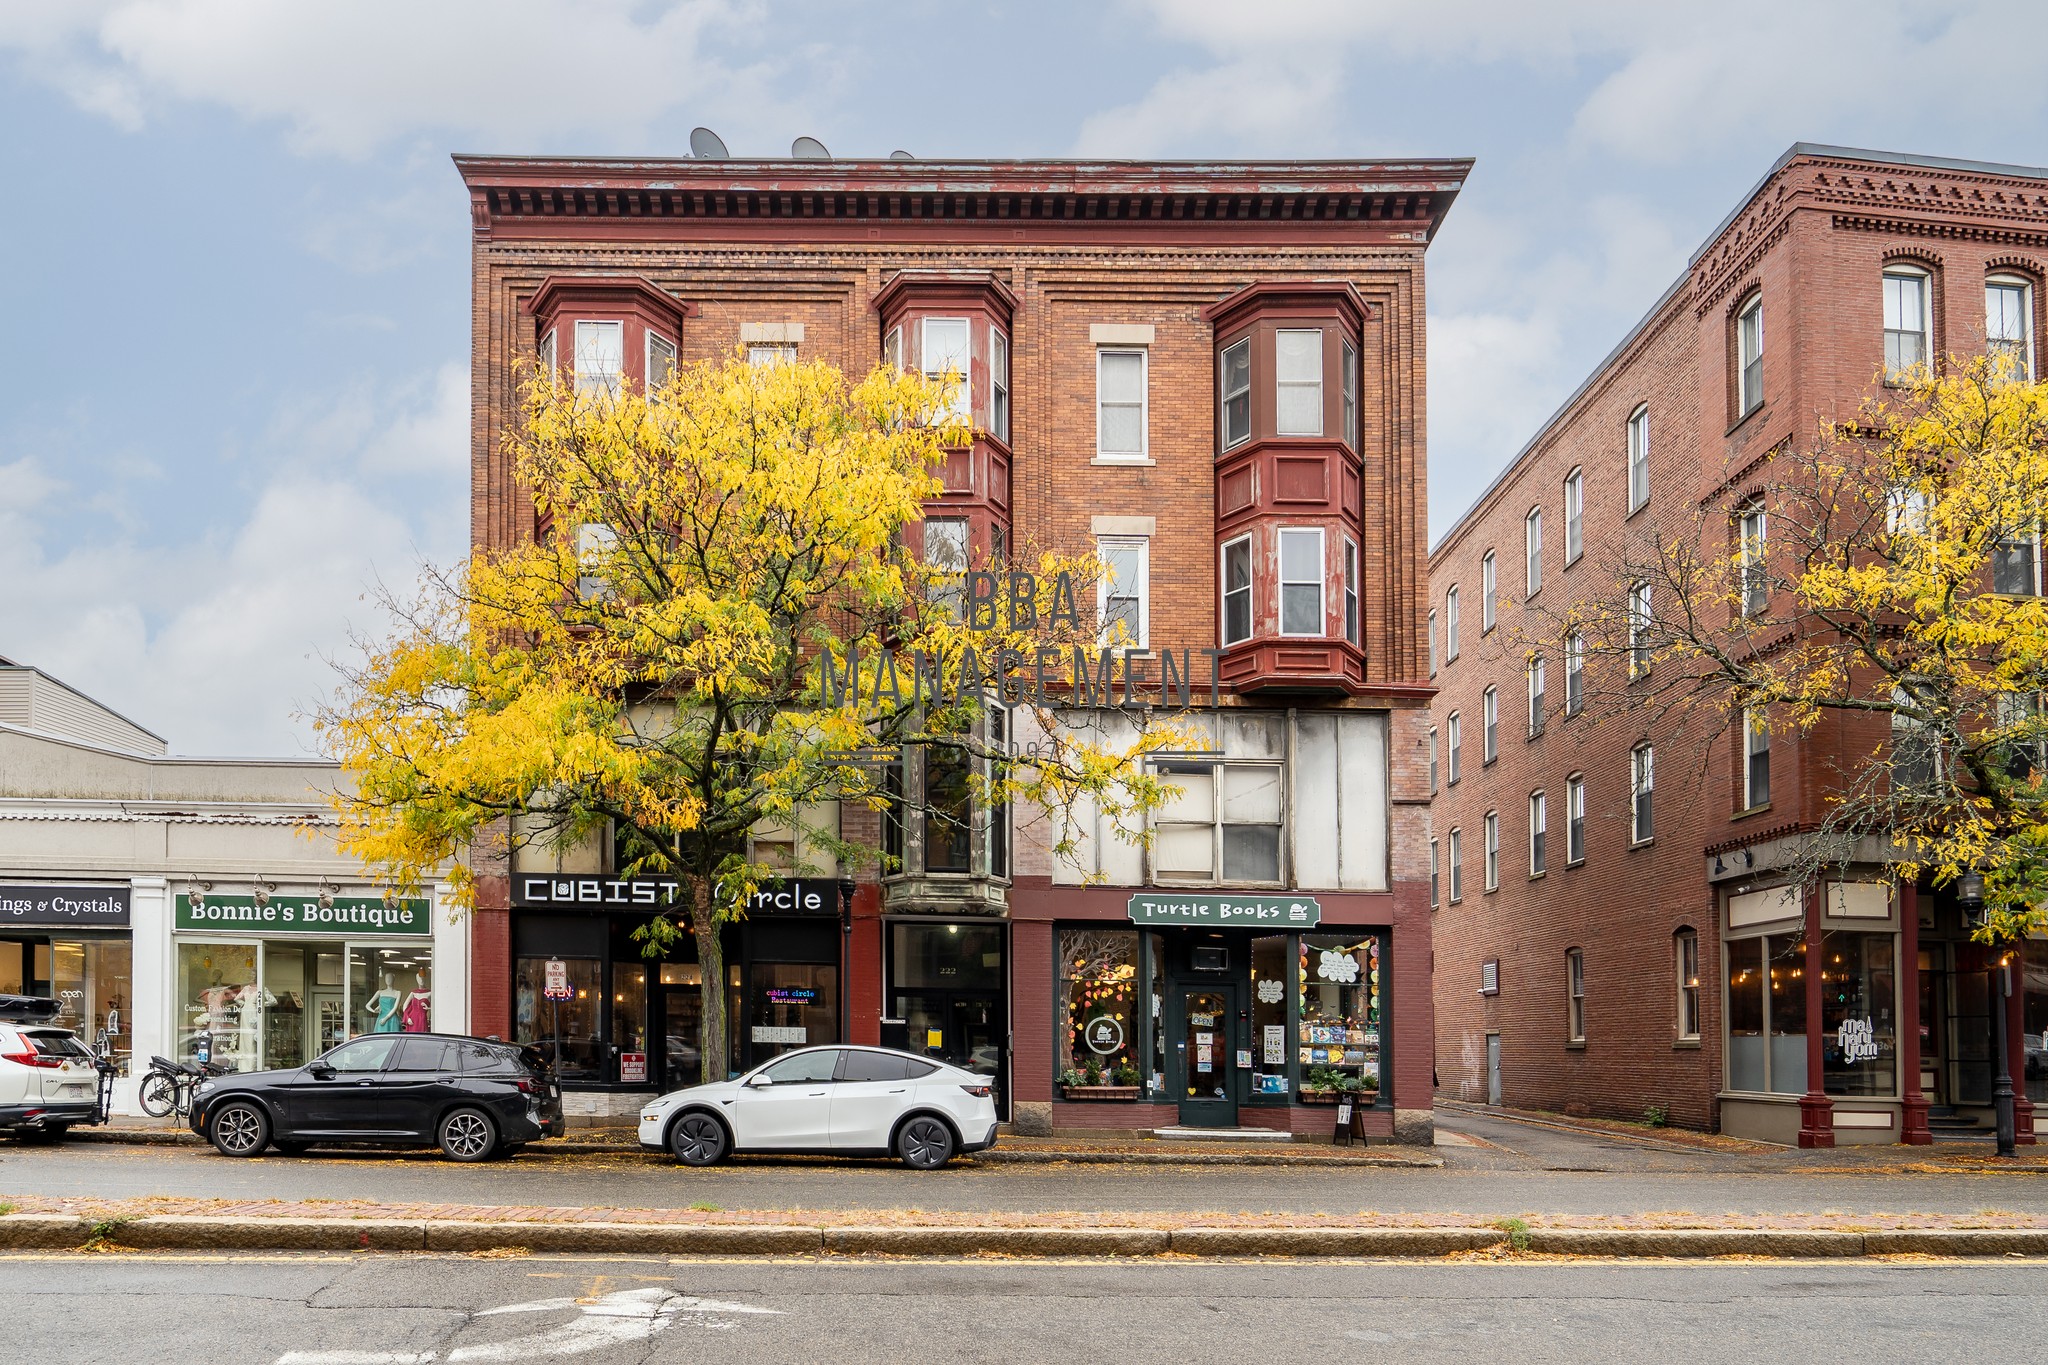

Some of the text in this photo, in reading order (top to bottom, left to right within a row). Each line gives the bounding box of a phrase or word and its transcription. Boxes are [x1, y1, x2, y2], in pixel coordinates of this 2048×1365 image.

[524, 879, 679, 904] CUBIST
[37, 901, 48, 912] &
[52, 896, 122, 916] Crystals
[190, 902, 414, 927] Bonnie's Boutique
[1142, 902, 1280, 919] Turtle Books
[61, 990, 84, 1003] open
[184, 1004, 206, 1012] Custom
[208, 1004, 232, 1013] Fashion
